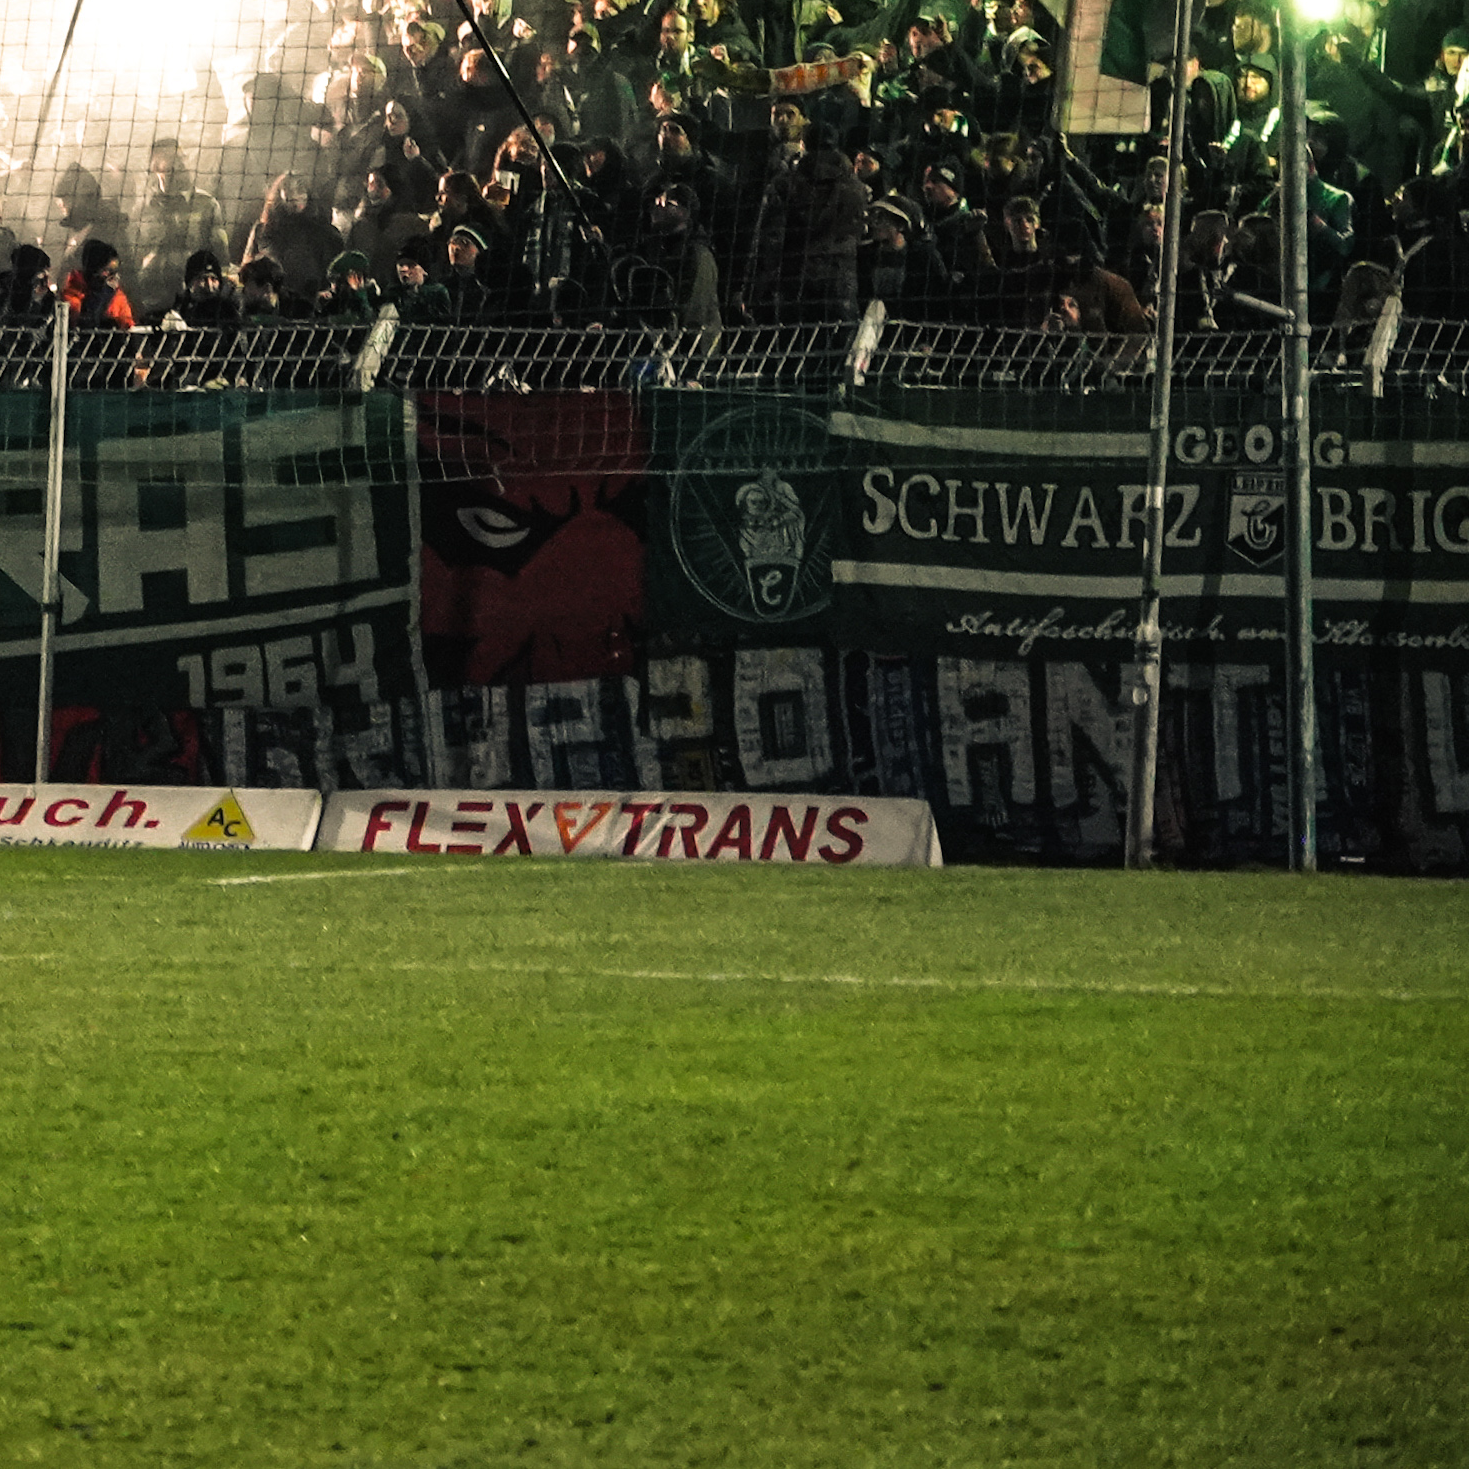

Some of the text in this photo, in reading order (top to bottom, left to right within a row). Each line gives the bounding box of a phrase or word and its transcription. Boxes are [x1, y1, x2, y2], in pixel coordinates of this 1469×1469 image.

[1174, 424, 1347, 470] GEOG
[863, 466, 1203, 548] SCHWARZ
[178, 624, 380, 709] 1964
[618, 802, 870, 864] TRANS
